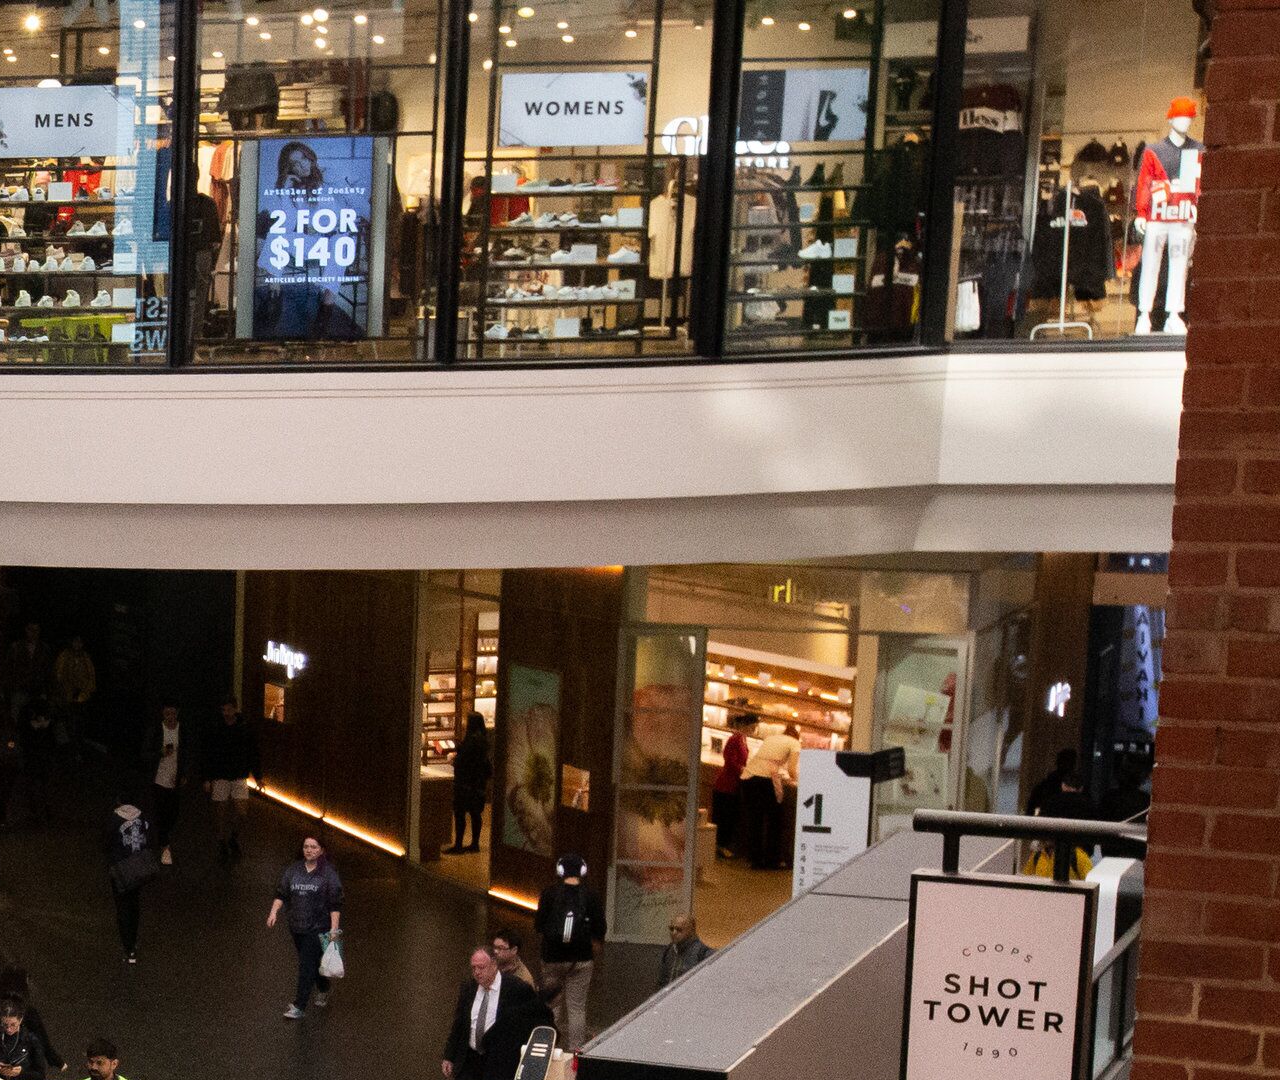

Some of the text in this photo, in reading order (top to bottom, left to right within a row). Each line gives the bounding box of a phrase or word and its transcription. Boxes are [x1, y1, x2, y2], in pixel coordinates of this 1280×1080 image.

[34, 112, 94, 128] MENS
[524, 99, 625, 117] WOMENS
[269, 208, 358, 234] 2 FOR
[269, 236, 356, 270] $140
[803, 793, 831, 833] 1
[962, 943, 1033, 964] COOPS
[944, 973, 1047, 1002] SHOT
[923, 1000, 1064, 1033] TOWER
[962, 1041, 1018, 1059] 1890
